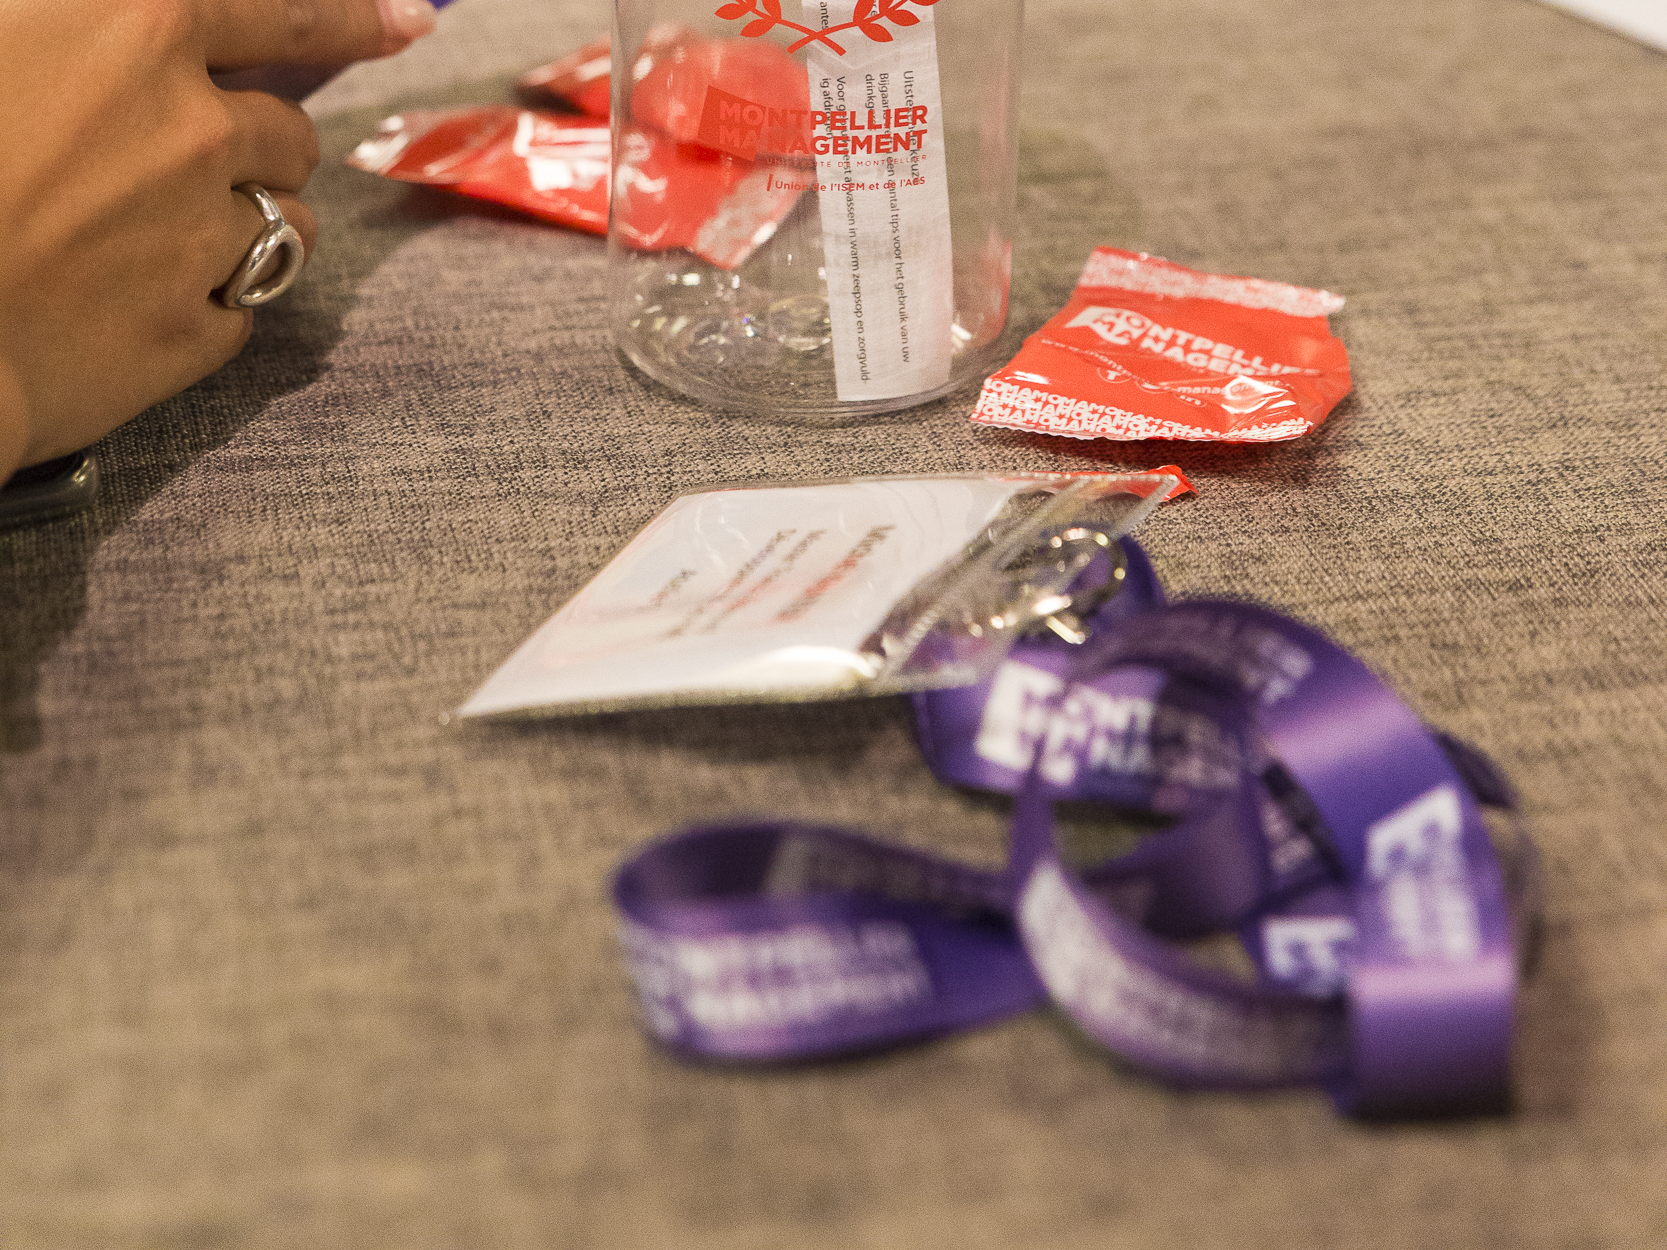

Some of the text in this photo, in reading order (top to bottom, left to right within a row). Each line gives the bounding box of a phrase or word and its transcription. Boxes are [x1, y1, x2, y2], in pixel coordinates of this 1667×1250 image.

[819, 1, 830, 30] antes
[836, 76, 847, 101] Voor
[719, 100, 929, 131] MONTPELLIER
[719, 125, 928, 156] MANAGEMENT
[775, 181, 809, 192] Union
[812, 182, 827, 192] de
[830, 182, 865, 192] l'ISEM
[868, 181, 880, 191] et
[884, 180, 897, 190] de
[848, 228, 858, 238] in
[889, 214, 902, 234] tips
[850, 240, 861, 271] warm
[893, 236, 903, 260] voor
[895, 262, 905, 280] het
[851, 273, 864, 318] zeepsop
[893, 282, 909, 323] gebruik
[856, 320, 866, 334] en
[899, 325, 909, 344] van
[902, 346, 911, 363] uw
